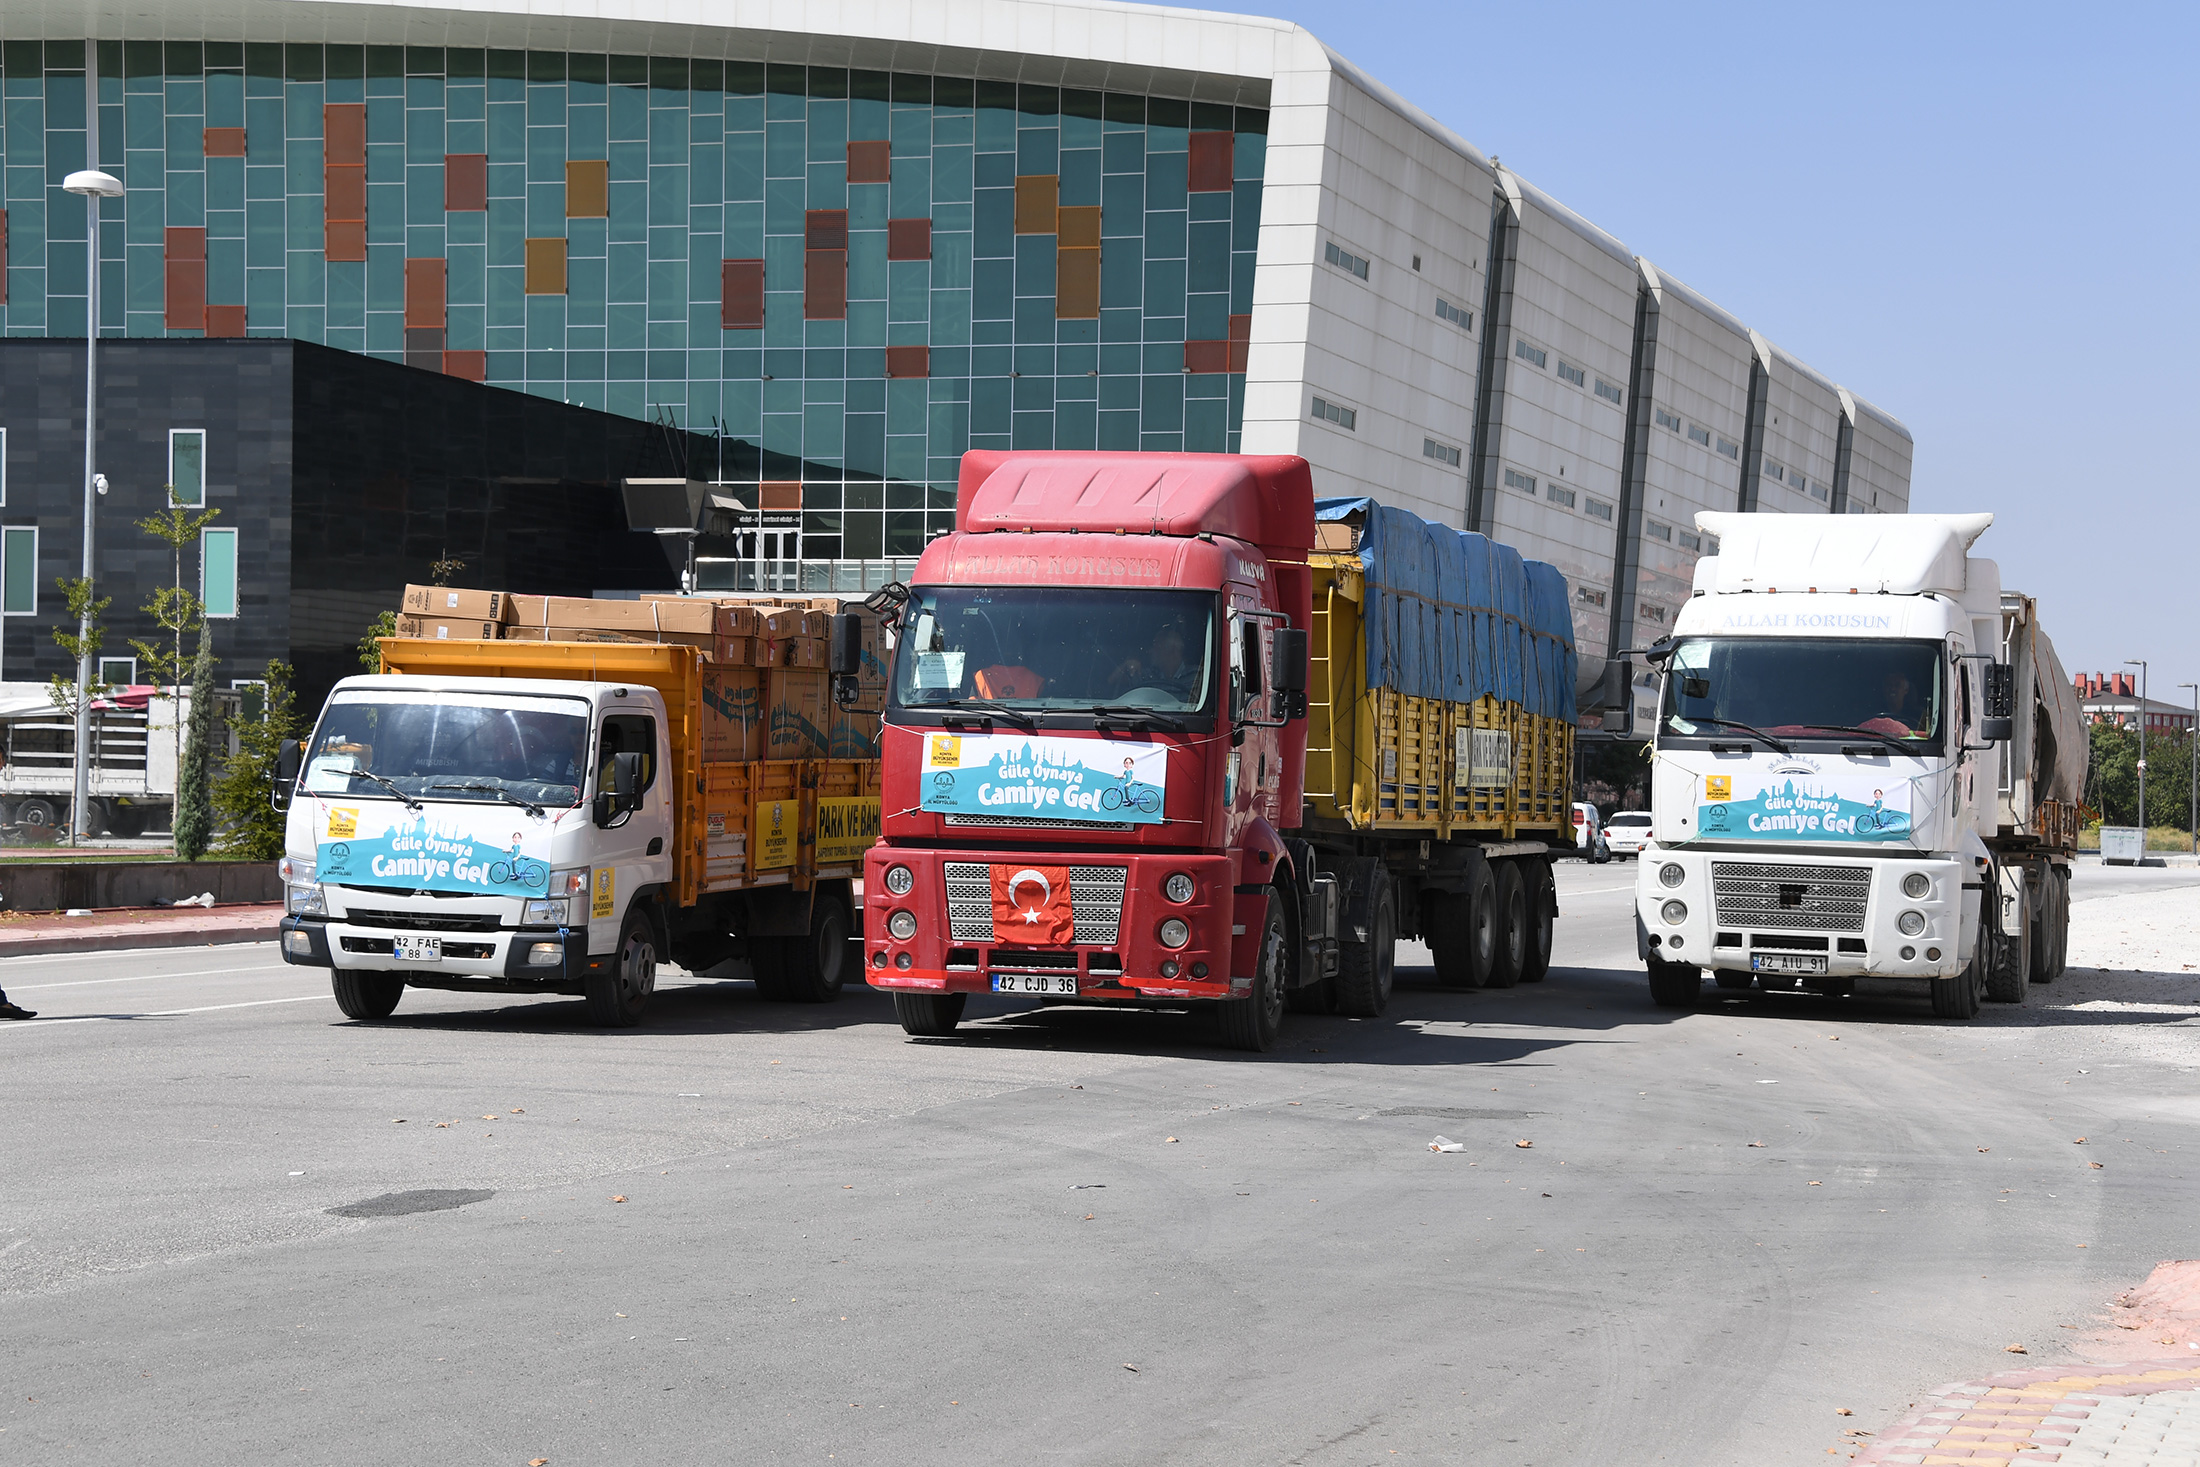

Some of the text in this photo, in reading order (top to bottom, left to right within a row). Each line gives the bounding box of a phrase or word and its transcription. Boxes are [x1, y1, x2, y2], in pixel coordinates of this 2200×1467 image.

[964, 555, 1161, 578] ALLAH KORUSUN
[1722, 614, 1891, 628] ALLAH KORUSUN
[416, 759, 459, 767] MITSUBISHI
[998, 764, 1084, 784] Güle Oynaya
[978, 779, 1102, 812] Camiye Gel
[1765, 797, 1839, 812] Güle Oynaya
[819, 805, 844, 838] PARK
[847, 804, 858, 837] VE
[1748, 809, 1856, 835] Camiye Gel
[392, 837, 473, 858] Güle Oynaya
[372, 851, 490, 886] Camiye Gel
[396, 938, 439, 948] 42 FAE
[408, 949, 420, 958] 88
[1760, 956, 1823, 970] 42 AIU 91
[1000, 976, 1015, 990] 42
[1025, 977, 1048, 991] CJD
[1058, 978, 1074, 992] 36
